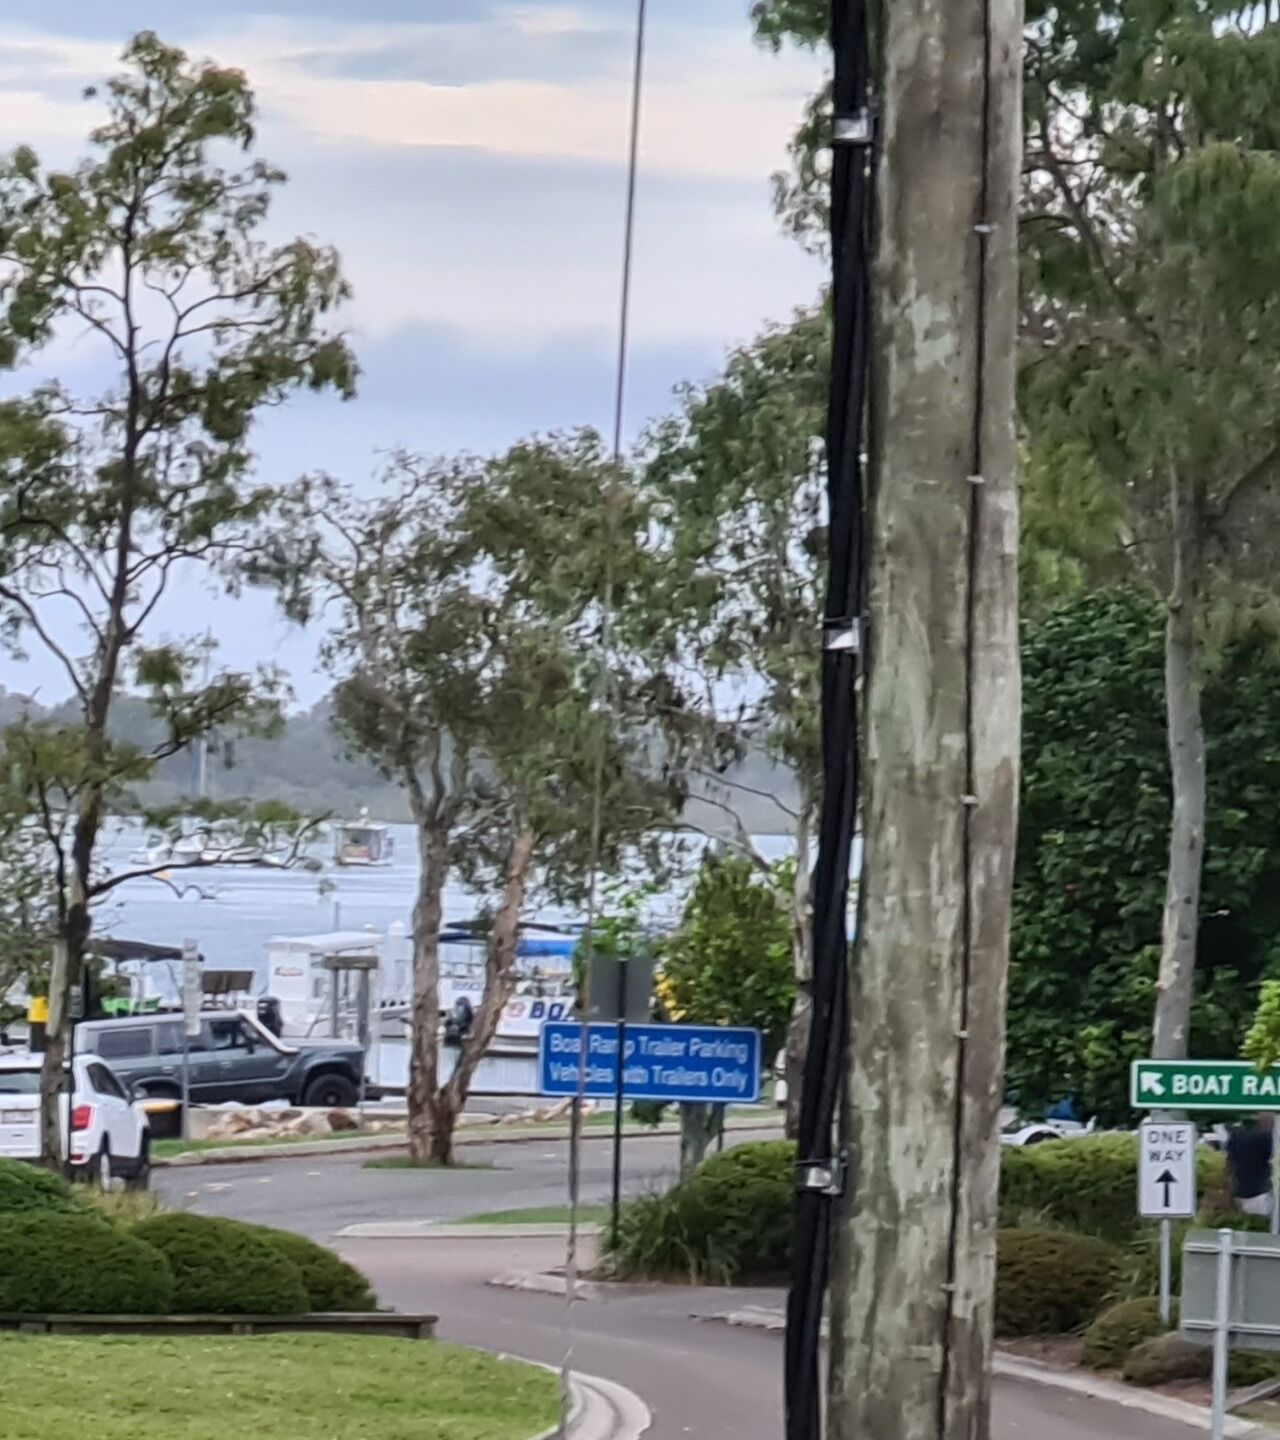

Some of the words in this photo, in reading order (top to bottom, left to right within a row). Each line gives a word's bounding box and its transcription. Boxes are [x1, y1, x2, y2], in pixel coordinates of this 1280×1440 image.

[550, 1032, 585, 1053] Boa
[638, 1035, 686, 1057] Trailer
[689, 1037, 748, 1064] Parking
[549, 1061, 614, 1084] Vehcles
[651, 1065, 708, 1087] Trailers
[711, 1067, 748, 1093] Only
[1171, 1073, 1233, 1095] BOAT
[1242, 1075, 1280, 1096] RA
[1148, 1130, 1187, 1144] ONE
[1148, 1149, 1186, 1162] WAY
